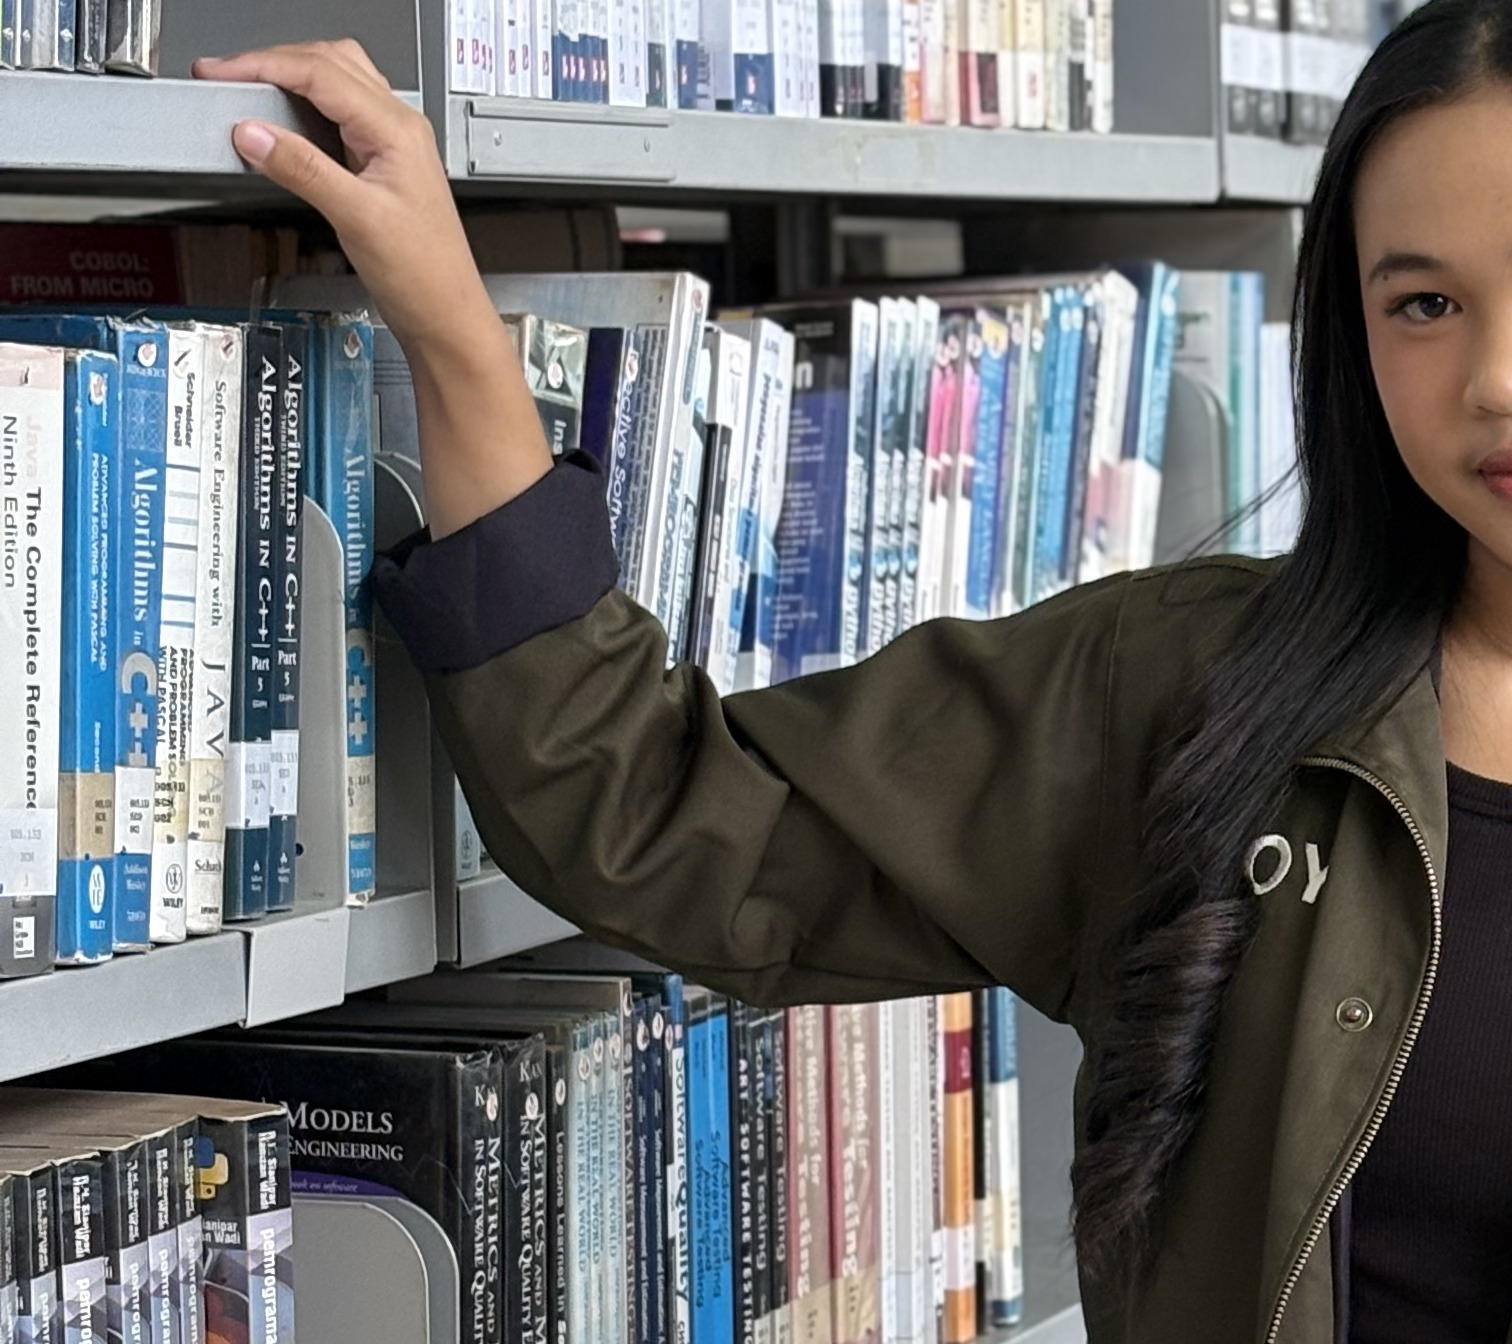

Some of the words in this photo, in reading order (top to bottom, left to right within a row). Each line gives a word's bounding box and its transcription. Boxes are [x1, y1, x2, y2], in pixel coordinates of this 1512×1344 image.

[12, 276, 74, 295] FROM
[81, 277, 154, 298] MICRO
[184, 372, 196, 448] Schneider
[213, 380, 228, 461] Software
[252, 354, 276, 531] Algorithms
[277, 354, 302, 527] Algorithms
[3, 415, 18, 486] Ninth
[26, 487, 42, 537] The
[100, 453, 109, 529] ADVANCED
[209, 469, 226, 582] Engineering
[343, 447, 367, 600] Algorithms
[4, 496, 19, 588] Edition
[130, 457, 158, 622] Algorithms
[258, 540, 271, 567] IN
[285, 536, 297, 563] IN
[23, 545, 41, 675] Complete
[99, 532, 108, 638] PROGRAMMING
[210, 587, 223, 627] with
[132, 631, 145, 646] in
[169, 646, 177, 679] AND
[251, 656, 270, 671] Part
[277, 650, 298, 665] Part
[169, 682, 178, 750] PROBLEM
[282, 1101, 393, 1134] MODELS
[738, 1059, 750, 1099] ART
[755, 1036, 767, 1161] Software
[774, 1031, 787, 1152] Software
[807, 1057, 820, 1148] Methods
[854, 1042, 869, 1133] Methods
[289, 1136, 403, 1161] ENGINEERING
[473, 1139, 486, 1161] IN
[520, 1115, 532, 1135] IN
[519, 1140, 532, 1241] SOFTWARE
[533, 1114, 547, 1257] METRICS
[556, 1130, 565, 1208] Lessons
[739, 1123, 751, 1244] SOFTWARE
[810, 1154, 822, 1186] for
[472, 1164, 486, 1266] SOFTWARE
[486, 1136, 501, 1282] METRICS
[756, 1174, 769, 1271] Testing
[775, 1161, 788, 1263] Testing
[795, 1155, 812, 1298] Testing
[840, 1144, 860, 1279] Testing
[519, 1243, 533, 1323] QUALITY
[533, 1265, 543, 1306] AND
[556, 1213, 566, 1289] Learned
[487, 1291, 496, 1334] AND
